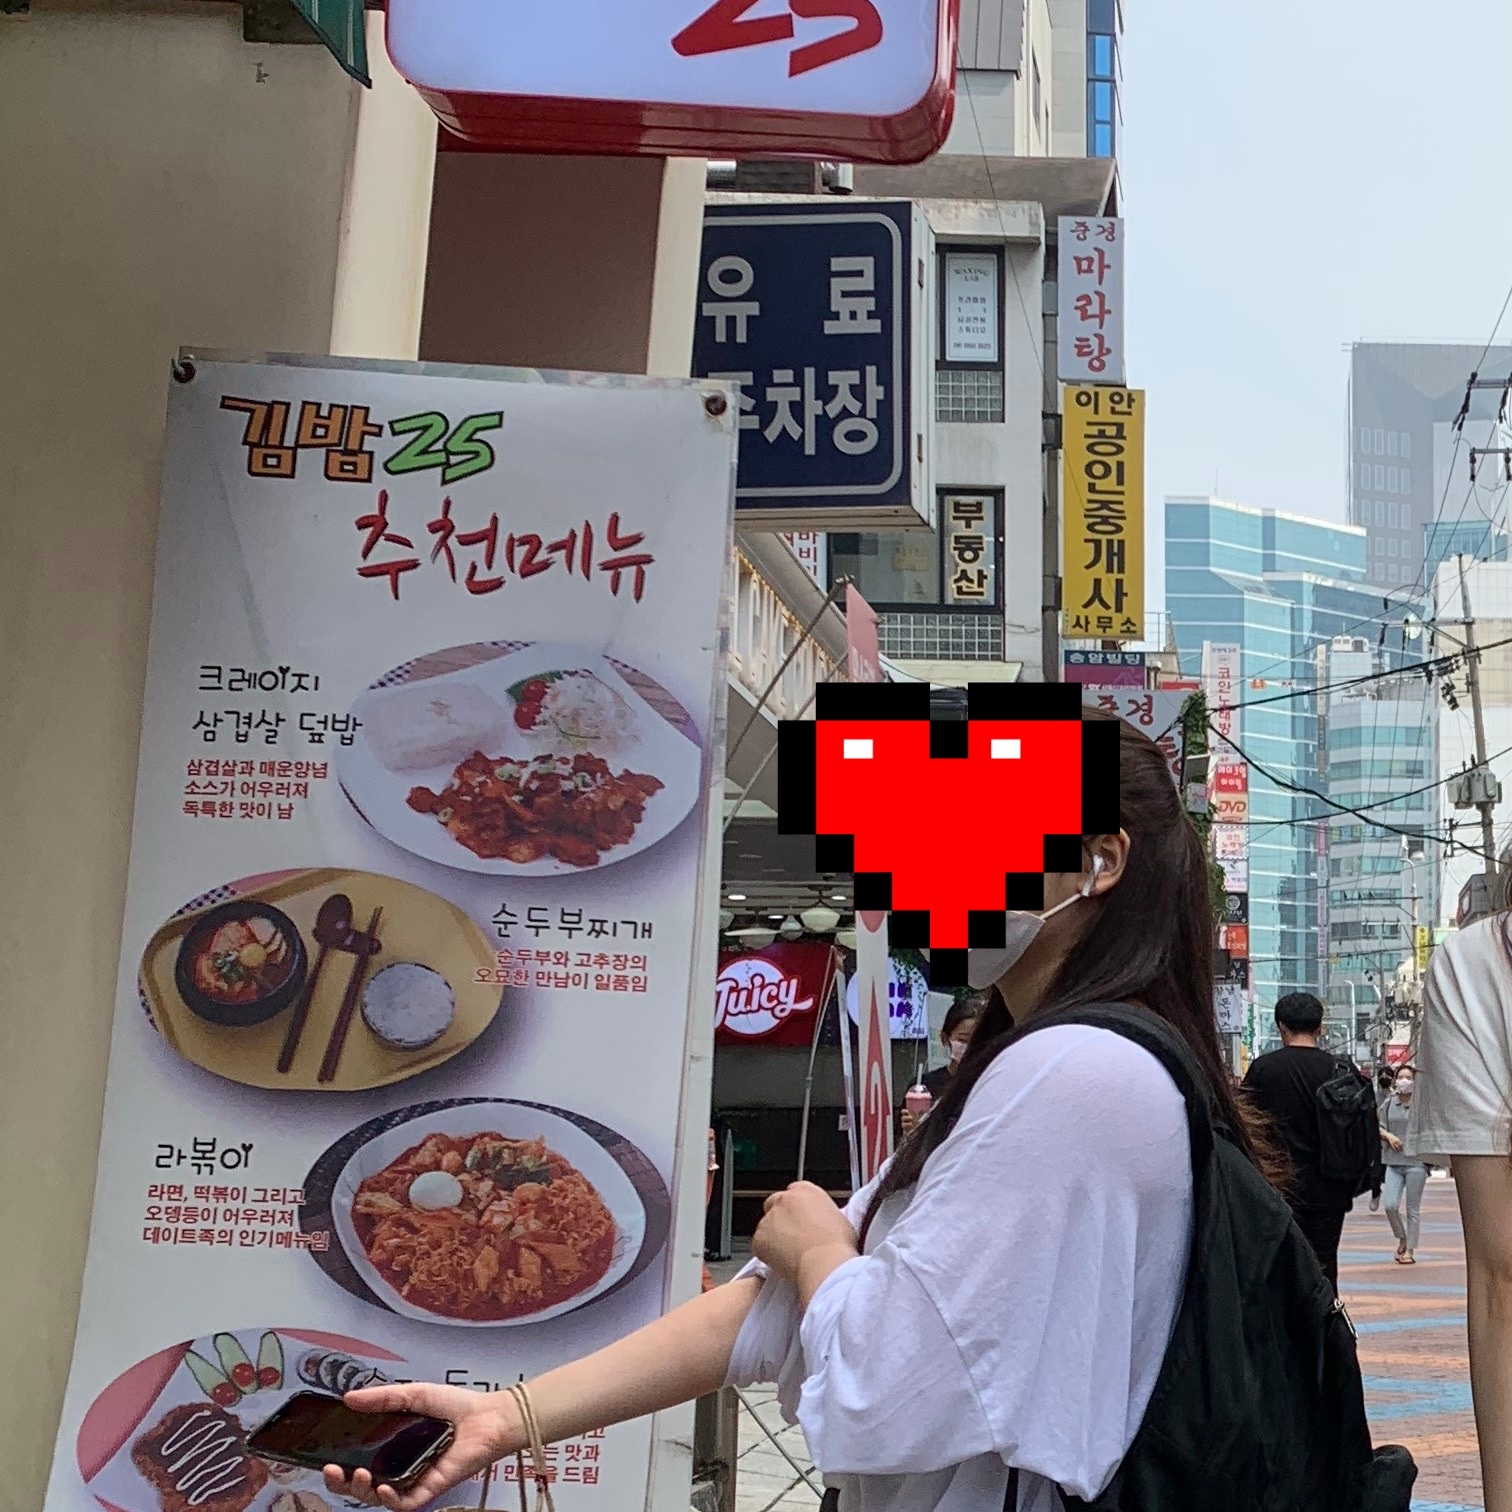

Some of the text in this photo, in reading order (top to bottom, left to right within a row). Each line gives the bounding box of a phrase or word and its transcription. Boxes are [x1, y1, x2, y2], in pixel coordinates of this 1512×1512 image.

[1073, 247, 1112, 372] 마라탕
[220, 396, 504, 486] 김밥25
[1082, 420, 1128, 614] 공인중개사
[354, 488, 654, 604] 추천메뉴
[952, 500, 988, 598] 부동산
[1072, 614, 1137, 634] 사무소
[198, 665, 320, 693] 크레이지
[192, 709, 363, 747] 삼겹살 덮밥
[186, 758, 328, 779] 삼겹살과 매운양념
[184, 780, 309, 799] 소스가 어우러져
[182, 801, 294, 820] 독특한 맛이 남
[491, 903, 653, 940] 순두부찌개
[497, 949, 648, 972] 순두부와 고추장의
[474, 968, 648, 993] 오묘한 만남이 일품임
[714, 972, 814, 1030] Juicy
[155, 1137, 254, 1176] 라볶이
[148, 1184, 307, 1206] 라면, 떡볶이 그리고
[145, 1205, 295, 1227] 오뎅등이 어우러져
[143, 1227, 234, 1246] 데이트족의
[565, 1444, 600, 1463] 맛과
[562, 1466, 600, 1485] 드림
